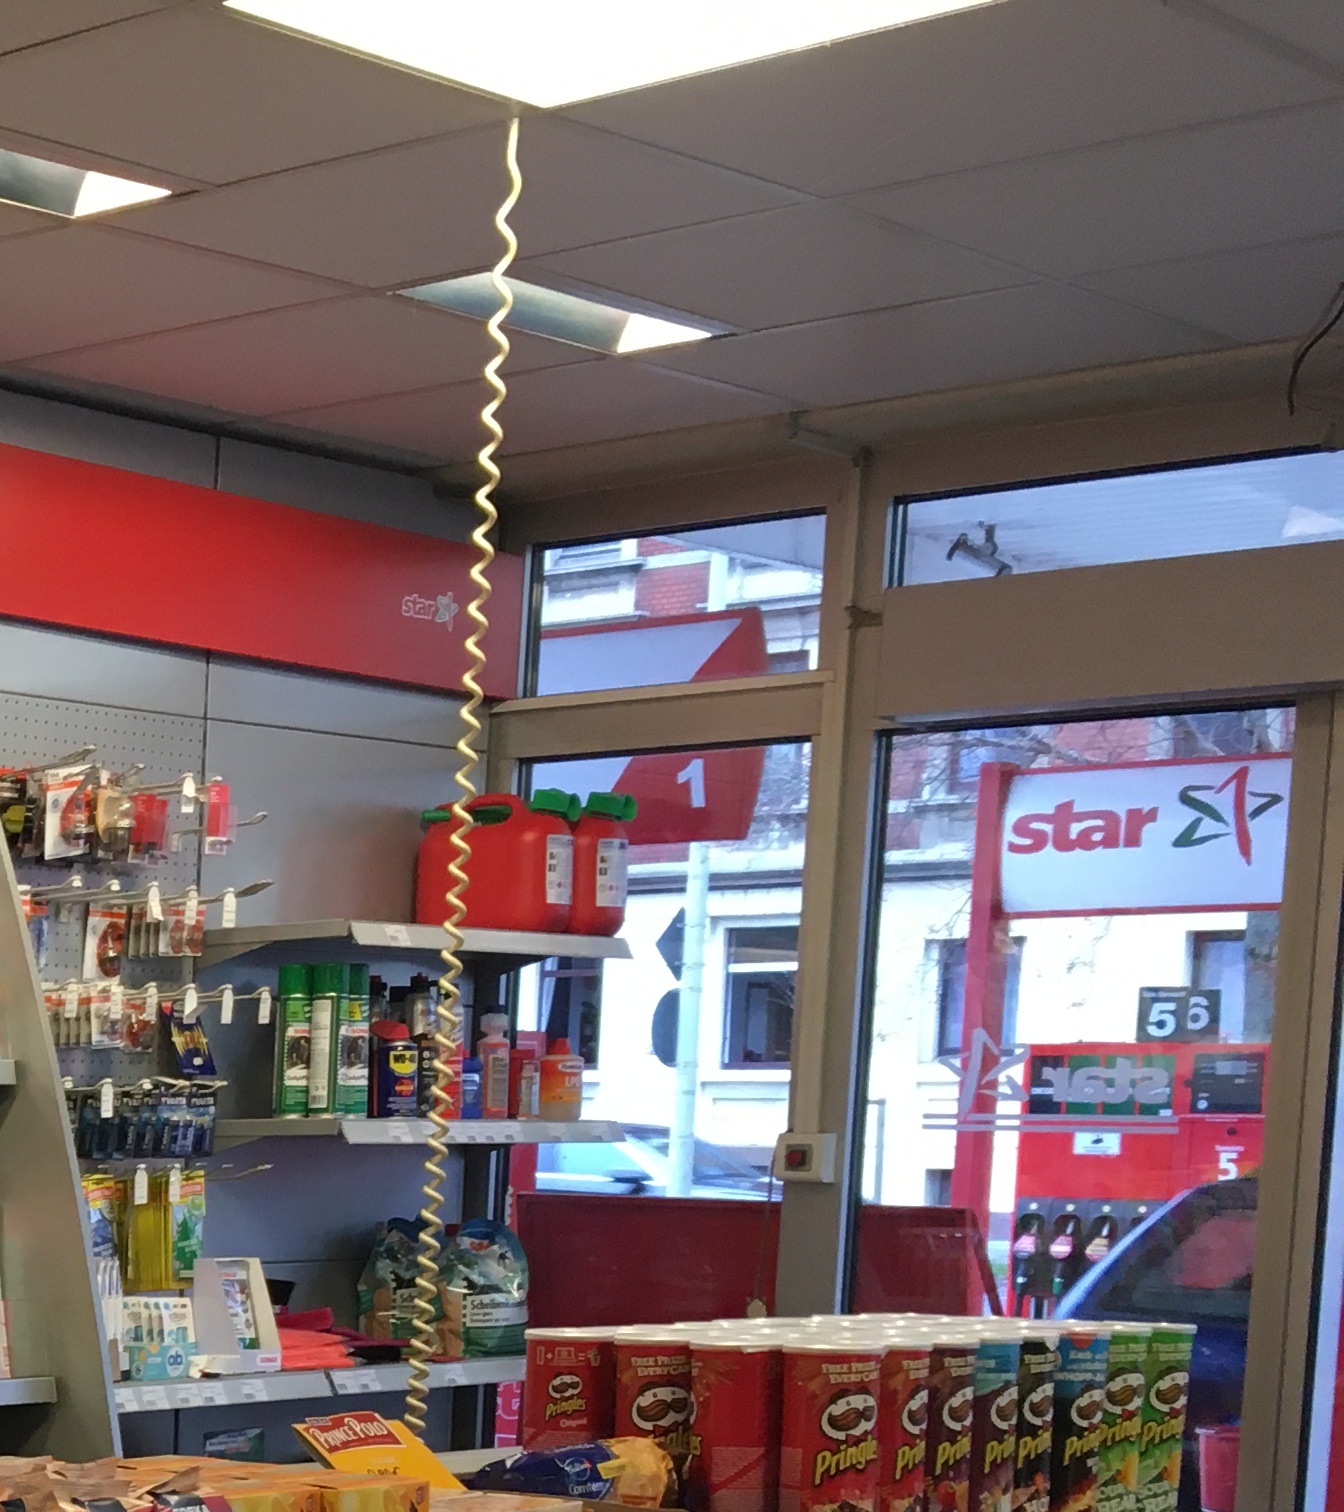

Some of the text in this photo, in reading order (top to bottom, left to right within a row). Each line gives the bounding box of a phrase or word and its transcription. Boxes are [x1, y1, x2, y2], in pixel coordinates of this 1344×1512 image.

[401, 594, 436, 620] star
[678, 759, 706, 810] 1
[1007, 800, 1159, 855] star
[1147, 996, 1210, 1038] 5 6
[1217, 1152, 1239, 1181] 5
[545, 1397, 587, 1422] Pringles
[313, 1418, 389, 1447] PRINCE POLO
